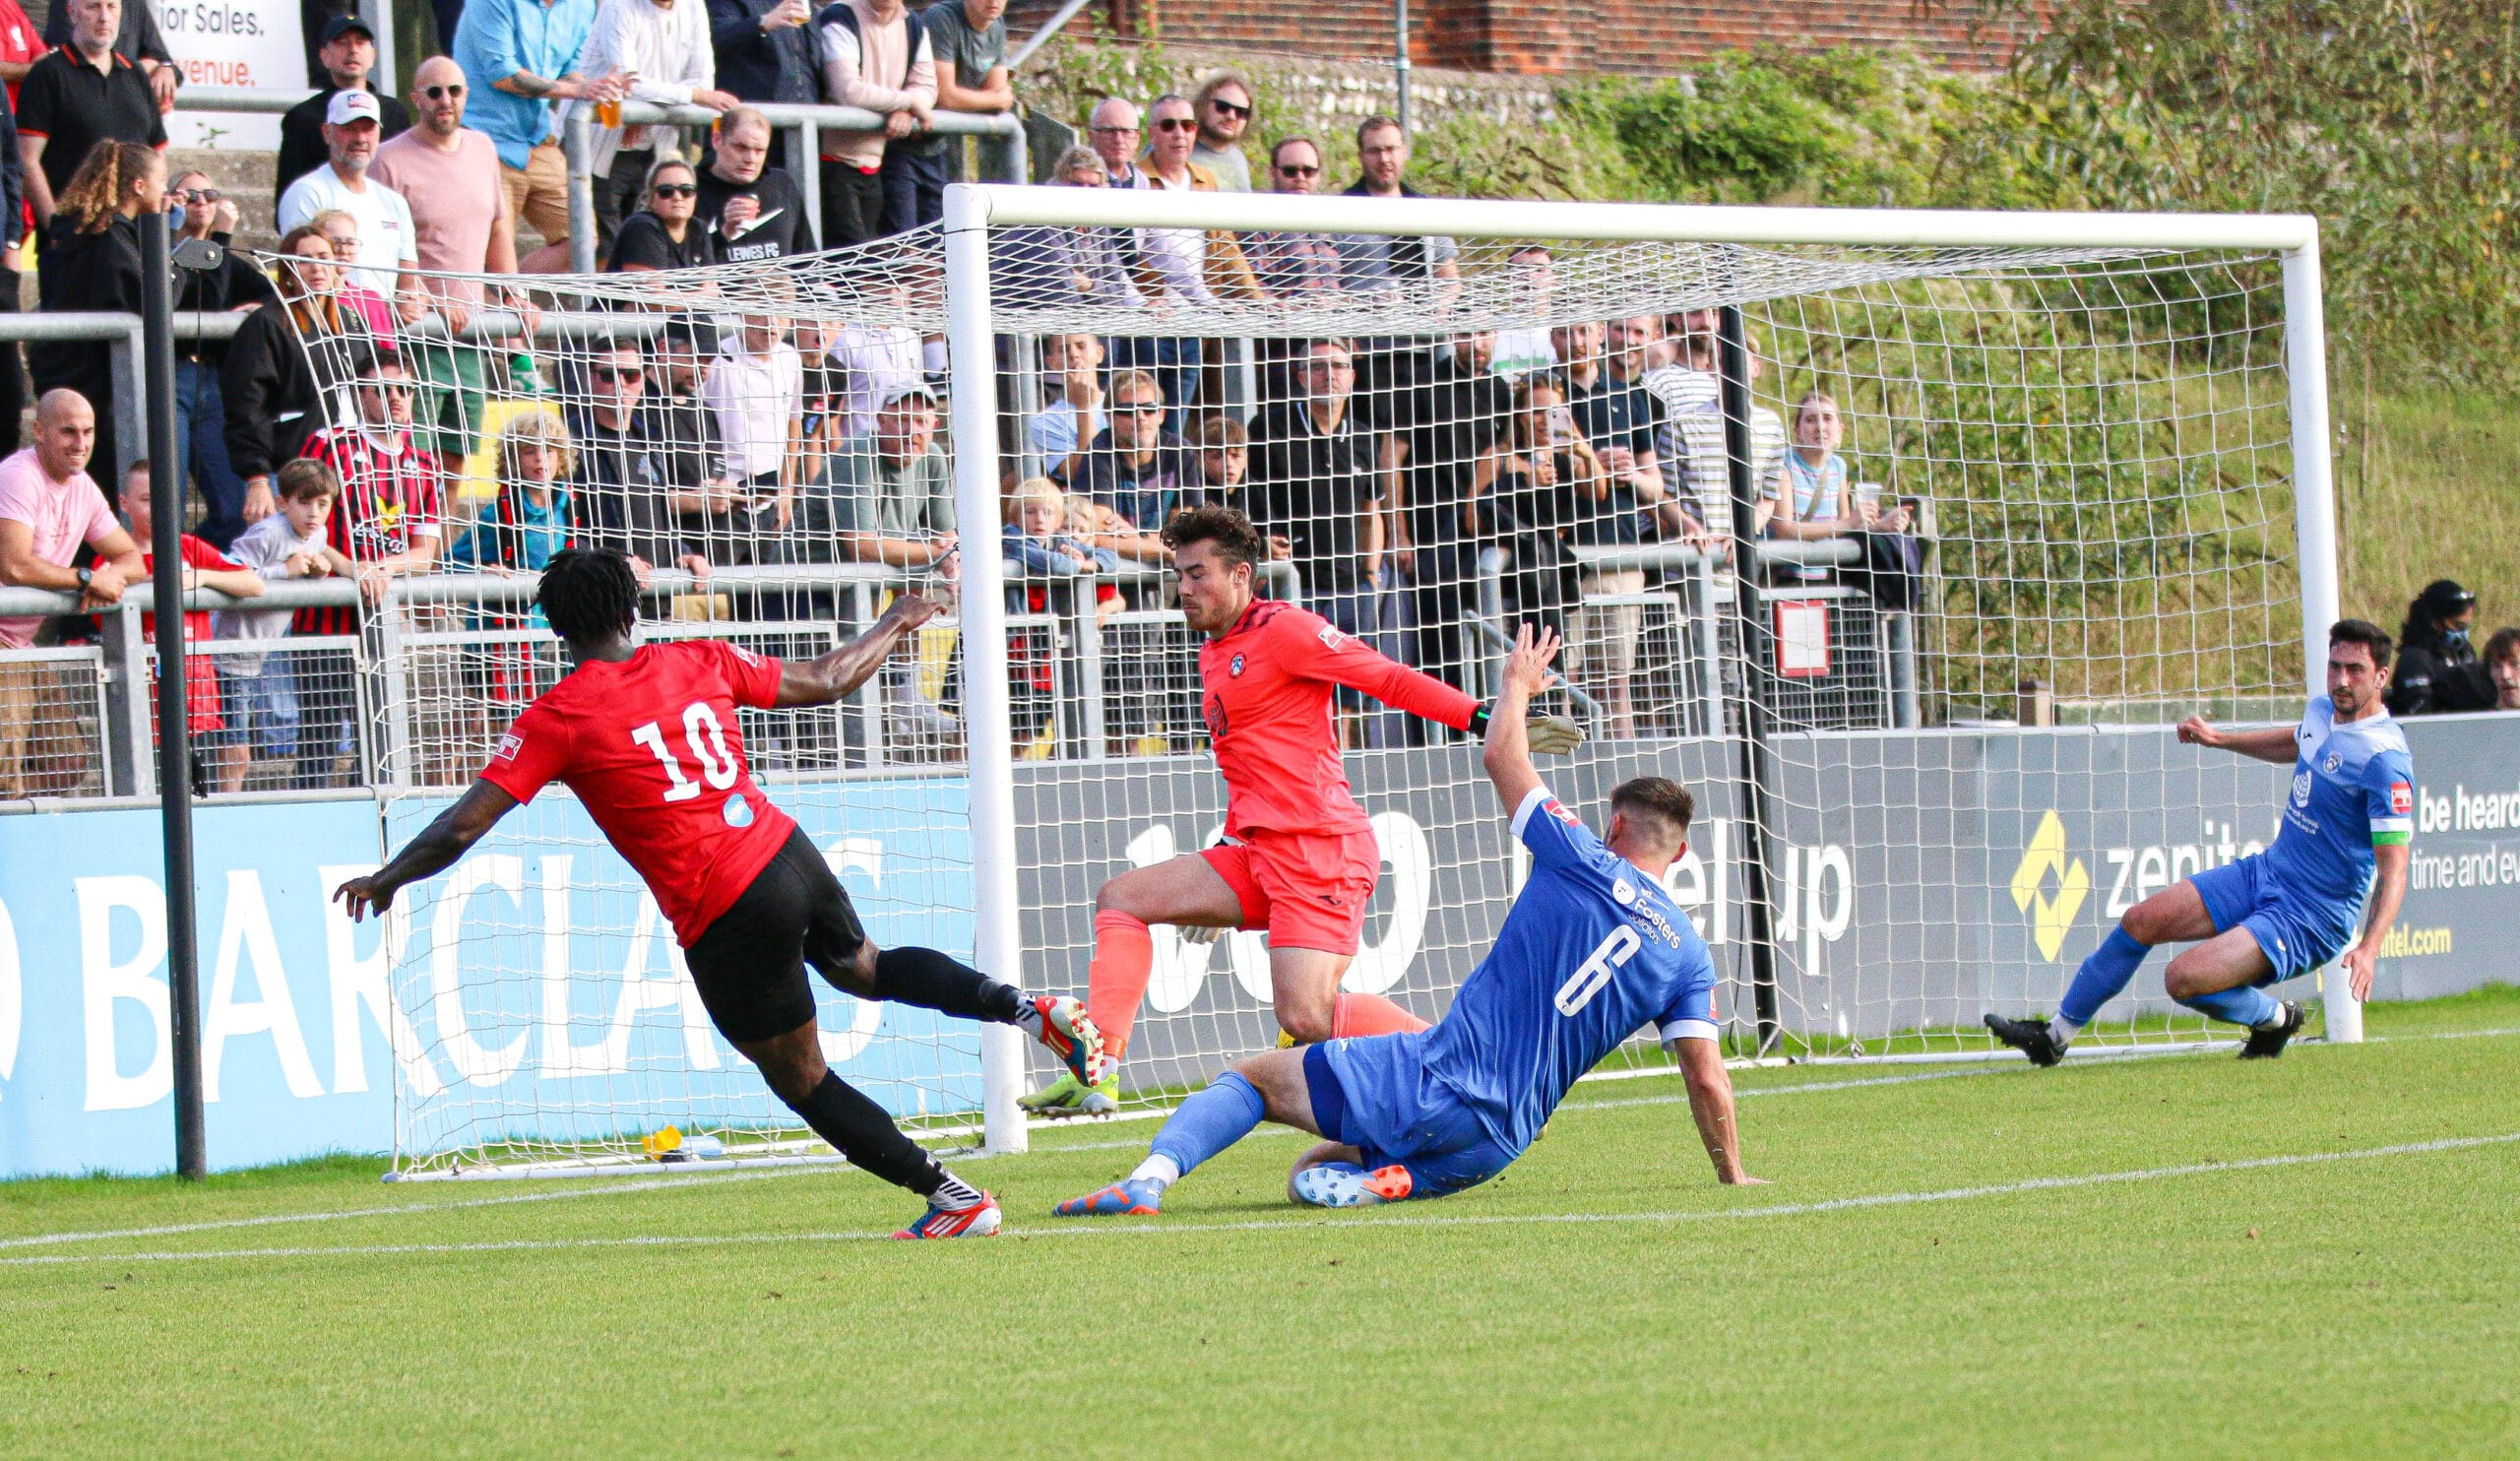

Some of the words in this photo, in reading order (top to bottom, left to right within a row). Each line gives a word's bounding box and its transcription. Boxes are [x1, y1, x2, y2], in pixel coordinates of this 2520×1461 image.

[158, 0, 189, 31] ior
[196, 4, 264, 35] Sales.
[173, 59, 256, 87] venue.
[726, 244, 765, 262] LEWES
[764, 242, 781, 259] FC
[631, 702, 738, 802] 10
[2419, 786, 2451, 833] be
[2456, 781, 2520, 831] heard
[2105, 819, 2281, 919] zenit
[2411, 848, 2456, 891] time
[2458, 844, 2496, 886] and
[1634, 897, 1681, 950] Fosters
[74, 838, 883, 1112] BARCLAS
[1554, 923, 1643, 1018] 6
